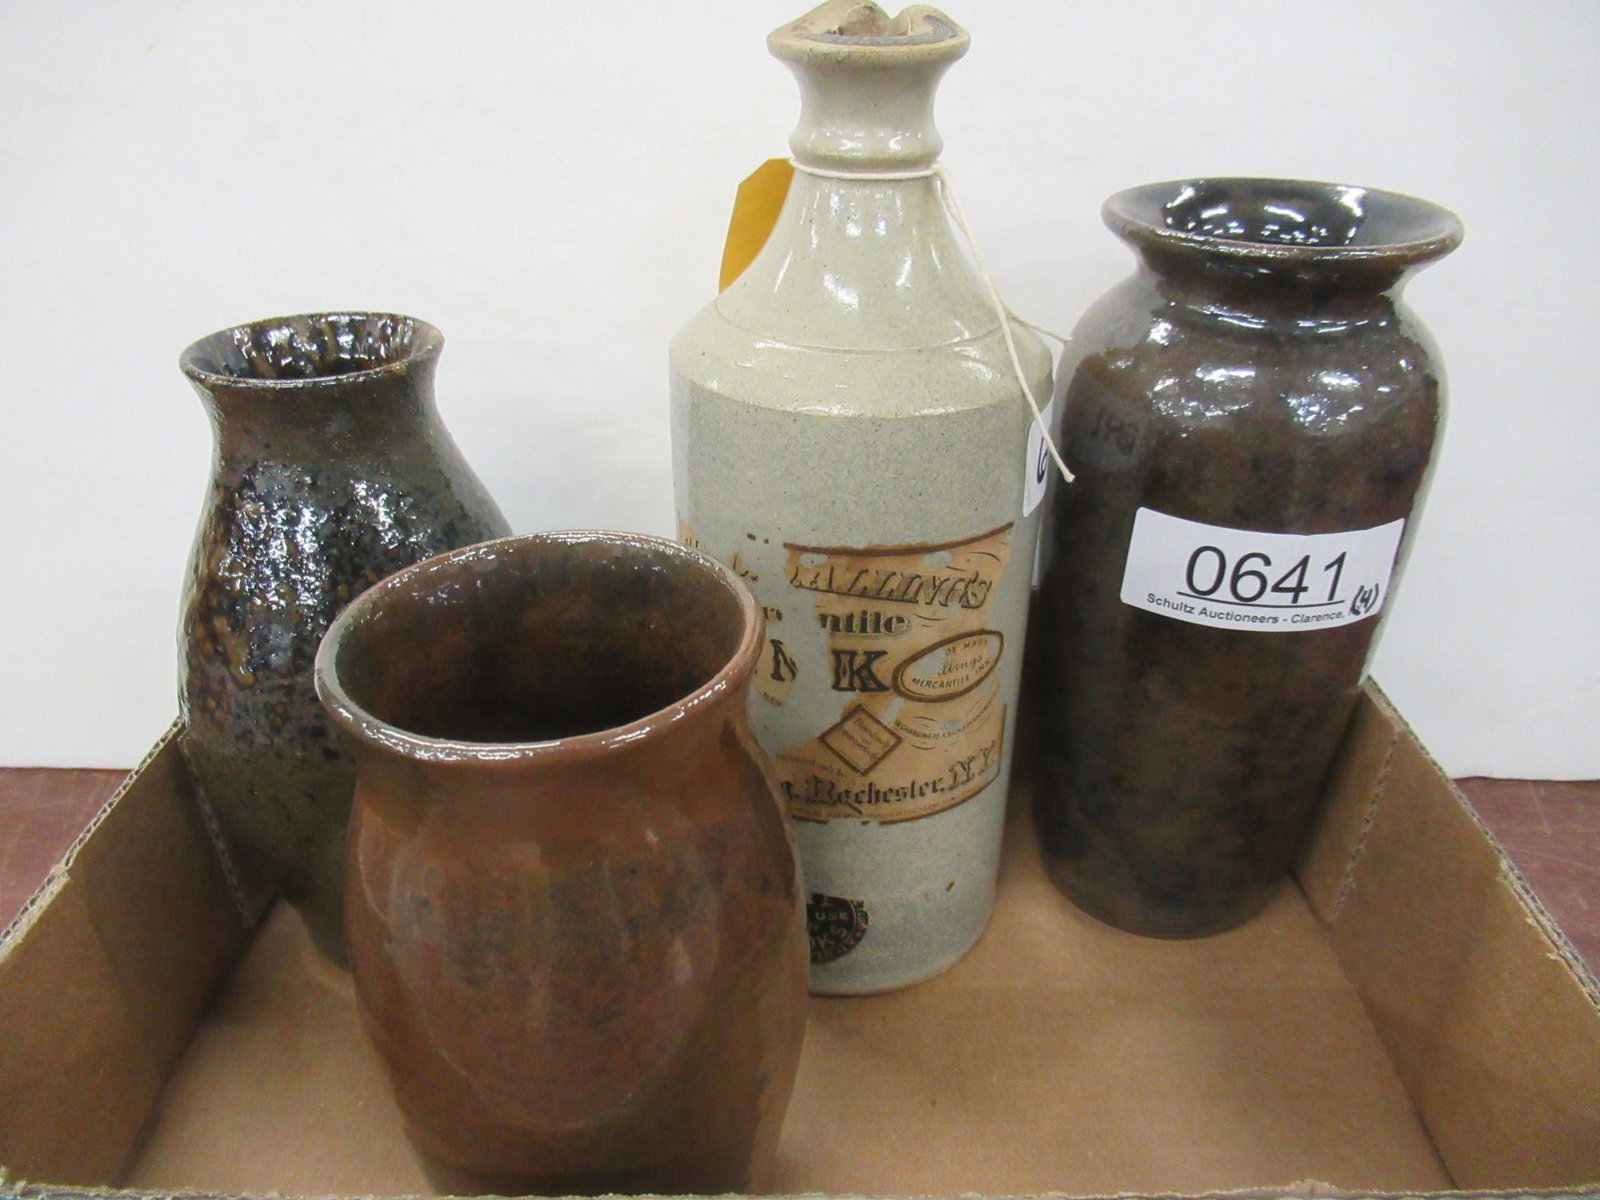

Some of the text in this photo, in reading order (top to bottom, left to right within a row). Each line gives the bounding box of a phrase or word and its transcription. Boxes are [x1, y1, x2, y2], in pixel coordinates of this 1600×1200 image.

[1186, 545, 1347, 604] 0641
[1147, 592, 1195, 615] Schultz
[1198, 606, 1279, 624] Auctioneers
